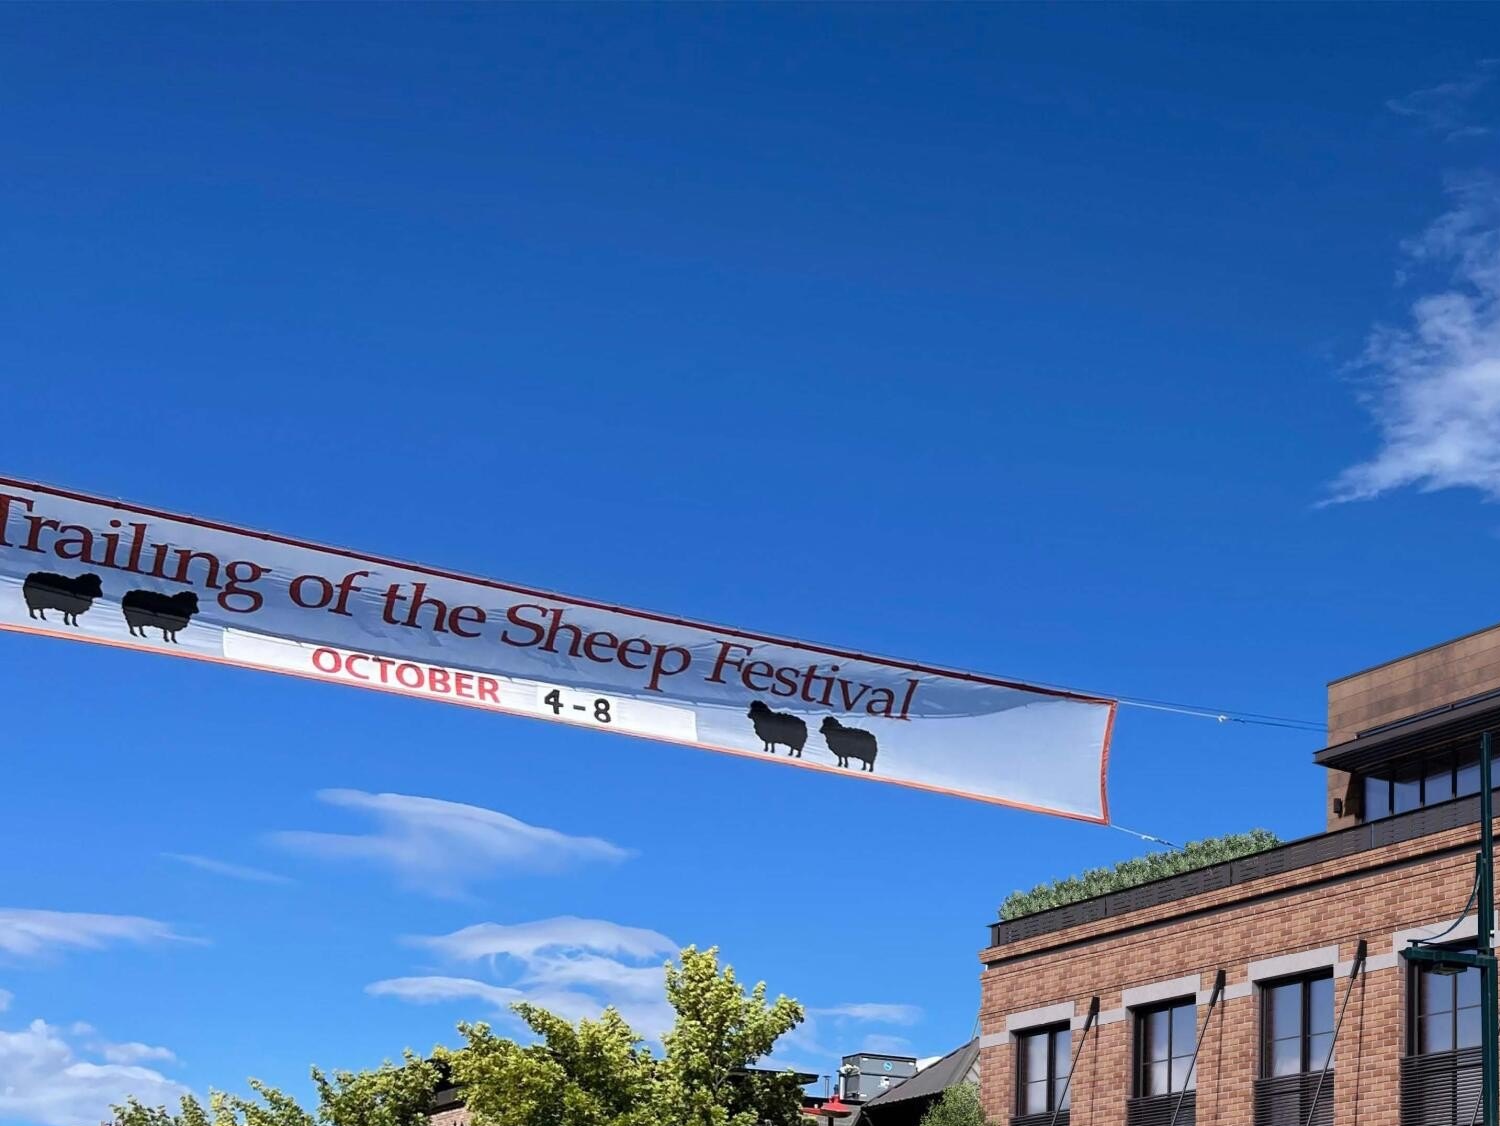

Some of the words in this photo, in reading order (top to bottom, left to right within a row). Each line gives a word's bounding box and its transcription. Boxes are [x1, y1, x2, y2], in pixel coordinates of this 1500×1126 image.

[0, 493, 272, 613] Trailing
[288, 570, 370, 617] of
[380, 581, 488, 638] the
[501, 603, 693, 693] Sheep
[704, 639, 920, 721] Festival
[311, 646, 501, 703] OCTOBER
